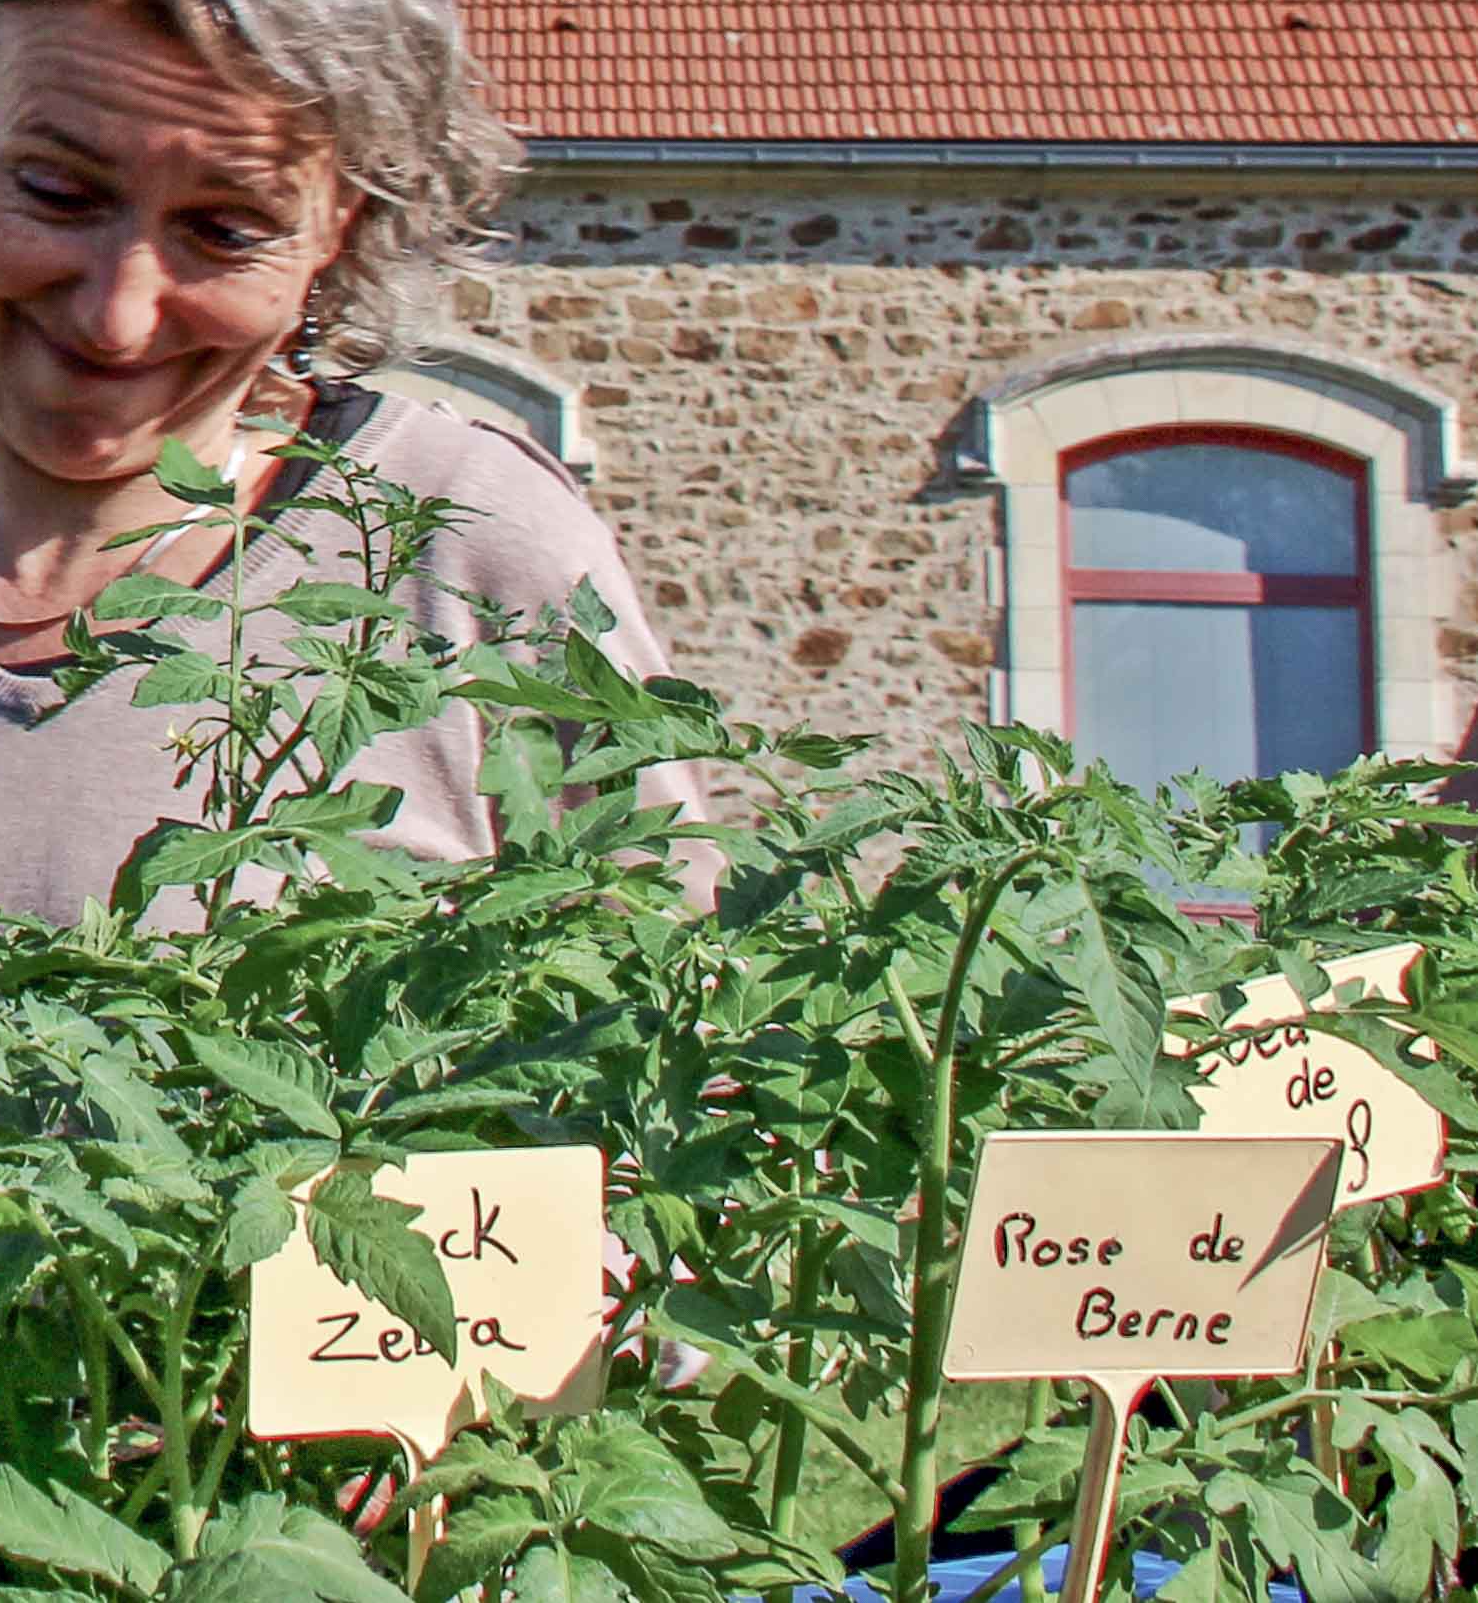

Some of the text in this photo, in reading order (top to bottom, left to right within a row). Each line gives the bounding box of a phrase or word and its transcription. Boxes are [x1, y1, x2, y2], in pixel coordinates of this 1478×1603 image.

[1286, 1057, 1338, 1110] de
[994, 1212, 1245, 1269] Rose de
[1075, 1285, 1233, 1345] Berne
